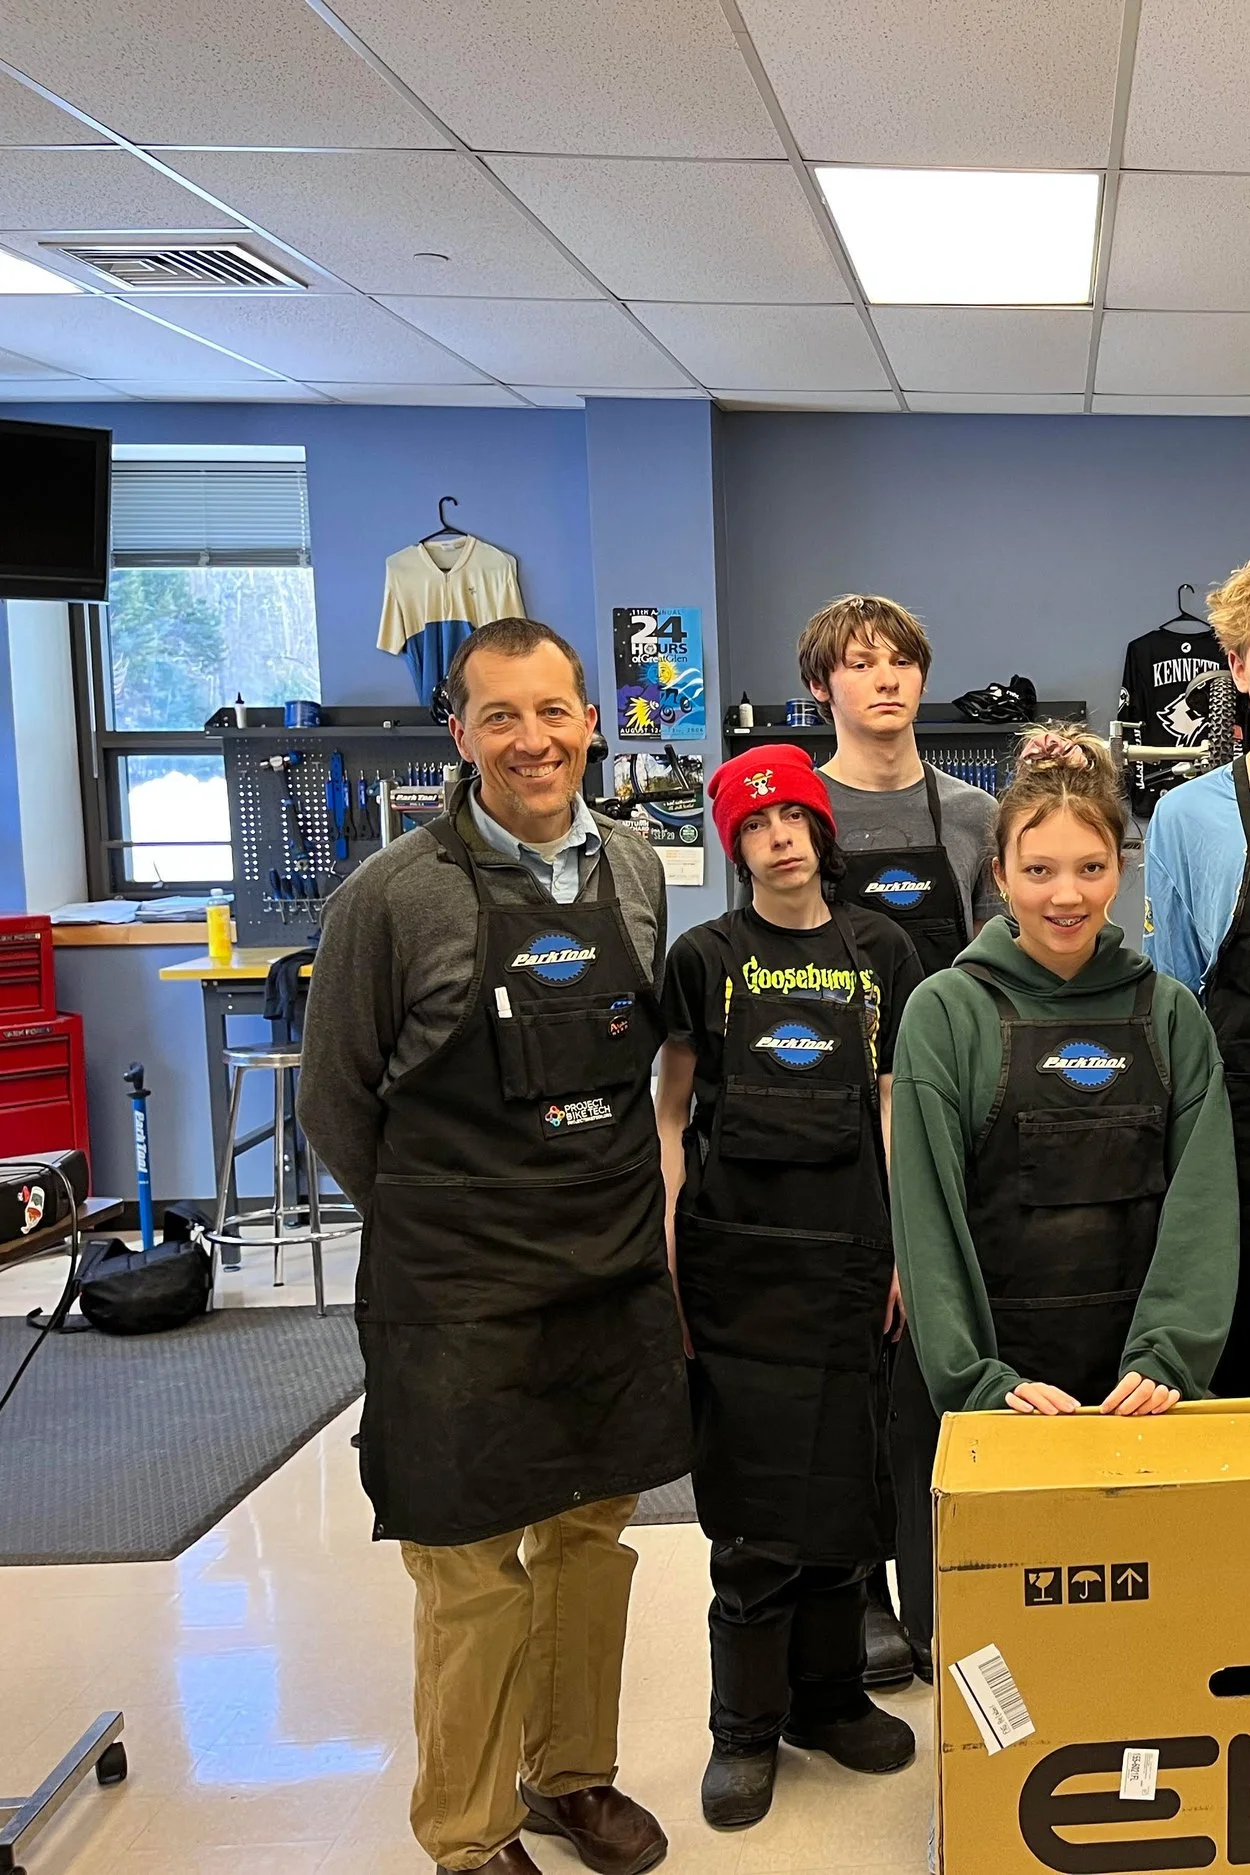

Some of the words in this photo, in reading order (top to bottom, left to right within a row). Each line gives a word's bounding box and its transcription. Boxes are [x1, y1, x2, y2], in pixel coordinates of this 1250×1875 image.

[631, 615, 688, 643] 24
[631, 643, 688, 655] HOURS
[564, 1097, 604, 1112] PROJECT
[566, 1109, 588, 1121] BIKE
[588, 1104, 611, 1117] TECH
